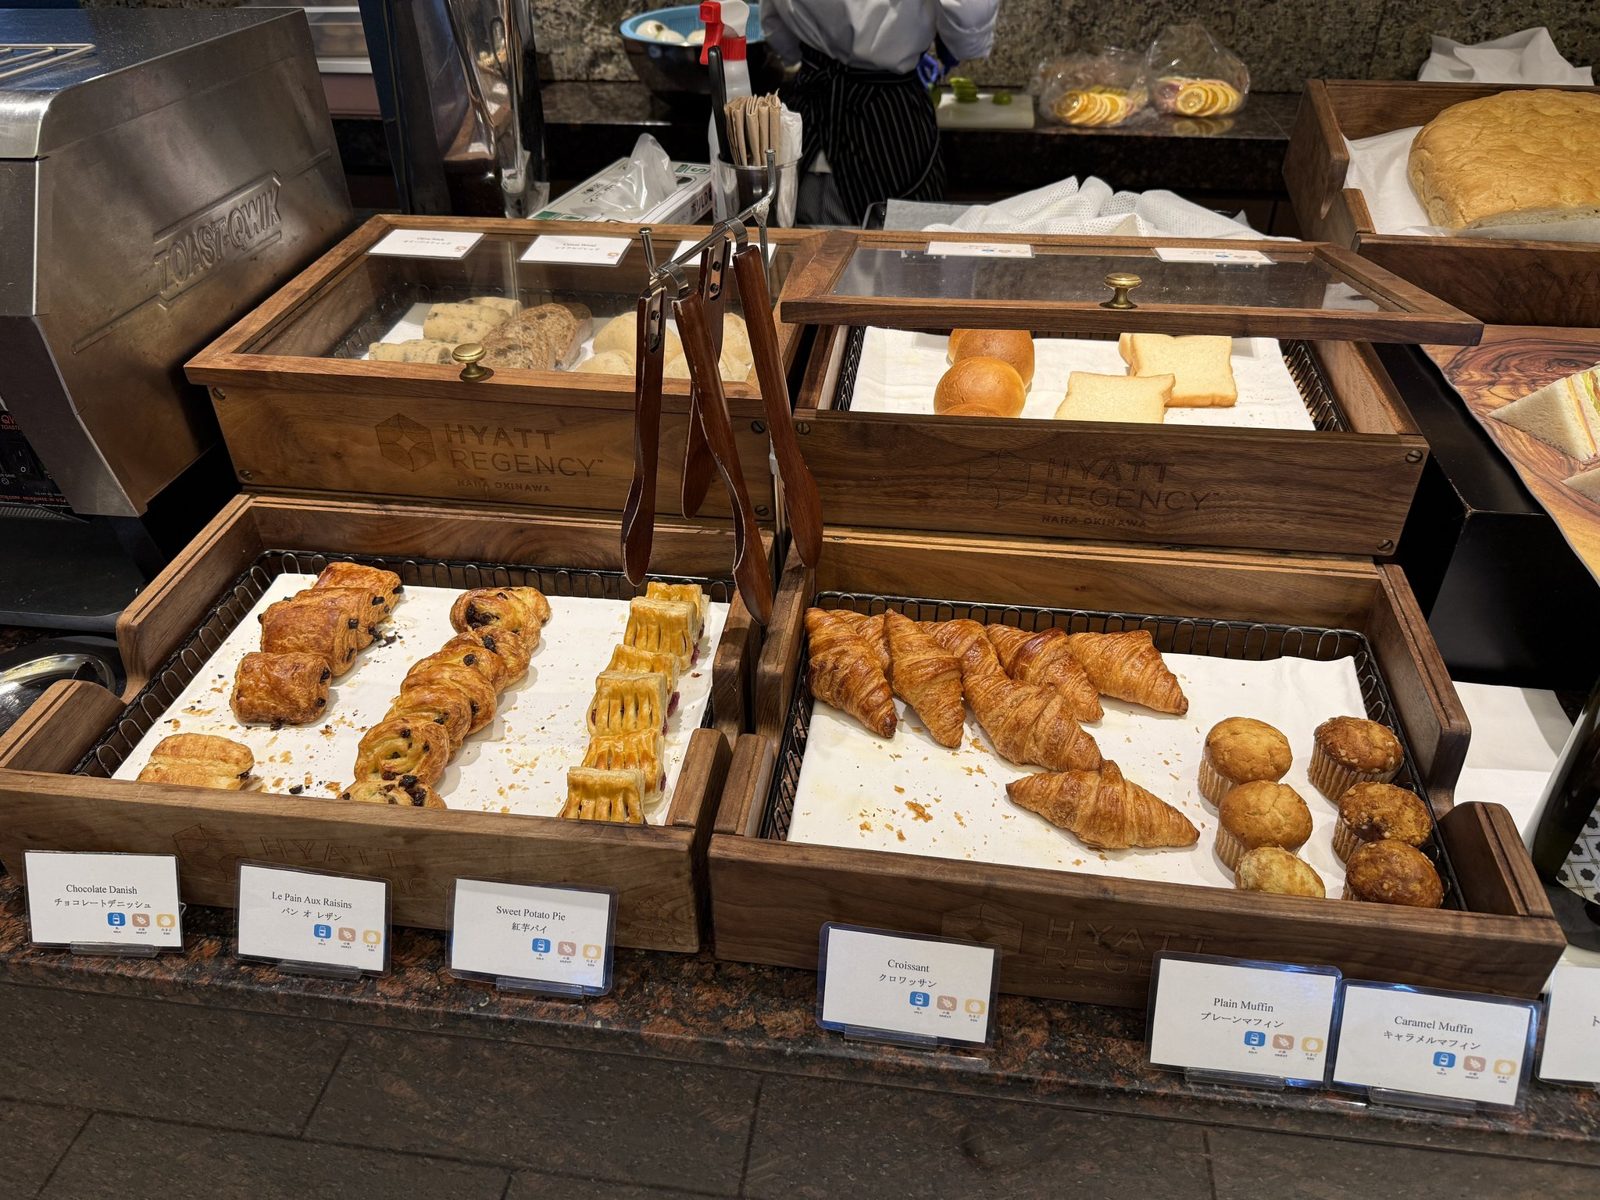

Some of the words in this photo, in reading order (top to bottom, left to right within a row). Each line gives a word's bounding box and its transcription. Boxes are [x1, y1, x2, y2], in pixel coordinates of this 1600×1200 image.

[445, 424, 555, 450] HYATT
[1048, 457, 1175, 484] HYATT
[495, 481, 551, 492] OKINAWA
[1083, 517, 1148, 529] OKINAWA
[66, 883, 107, 894] Chocolate
[109, 885, 138, 895] Danish
[54, 897, 152, 909] チョコレートデニッシュ
[272, 891, 283, 901] Le
[284, 893, 302, 904] Pain
[304, 896, 321, 906] Aux
[323, 898, 352, 909] Raisins
[281, 907, 298, 916] パン
[303, 909, 312, 918] オ
[317, 911, 342, 921] レザン
[496, 906, 521, 917] Sweet
[523, 909, 550, 920] Potato
[552, 911, 566, 922] Pie
[511, 922, 548, 934] 紅芋パイ
[1047, 917, 1215, 953] HYATT
[887, 959, 930, 973] Croissant
[879, 974, 937, 989] クロワッサン
[1213, 997, 1238, 1009] Plain
[1240, 1000, 1274, 1013] Muffin
[1201, 1012, 1285, 1029] プレーンマフィン
[1394, 1015, 1436, 1031] Caramel
[1438, 1020, 1474, 1035] Muffin
[1383, 1030, 1482, 1051] キャラメルマフィン
